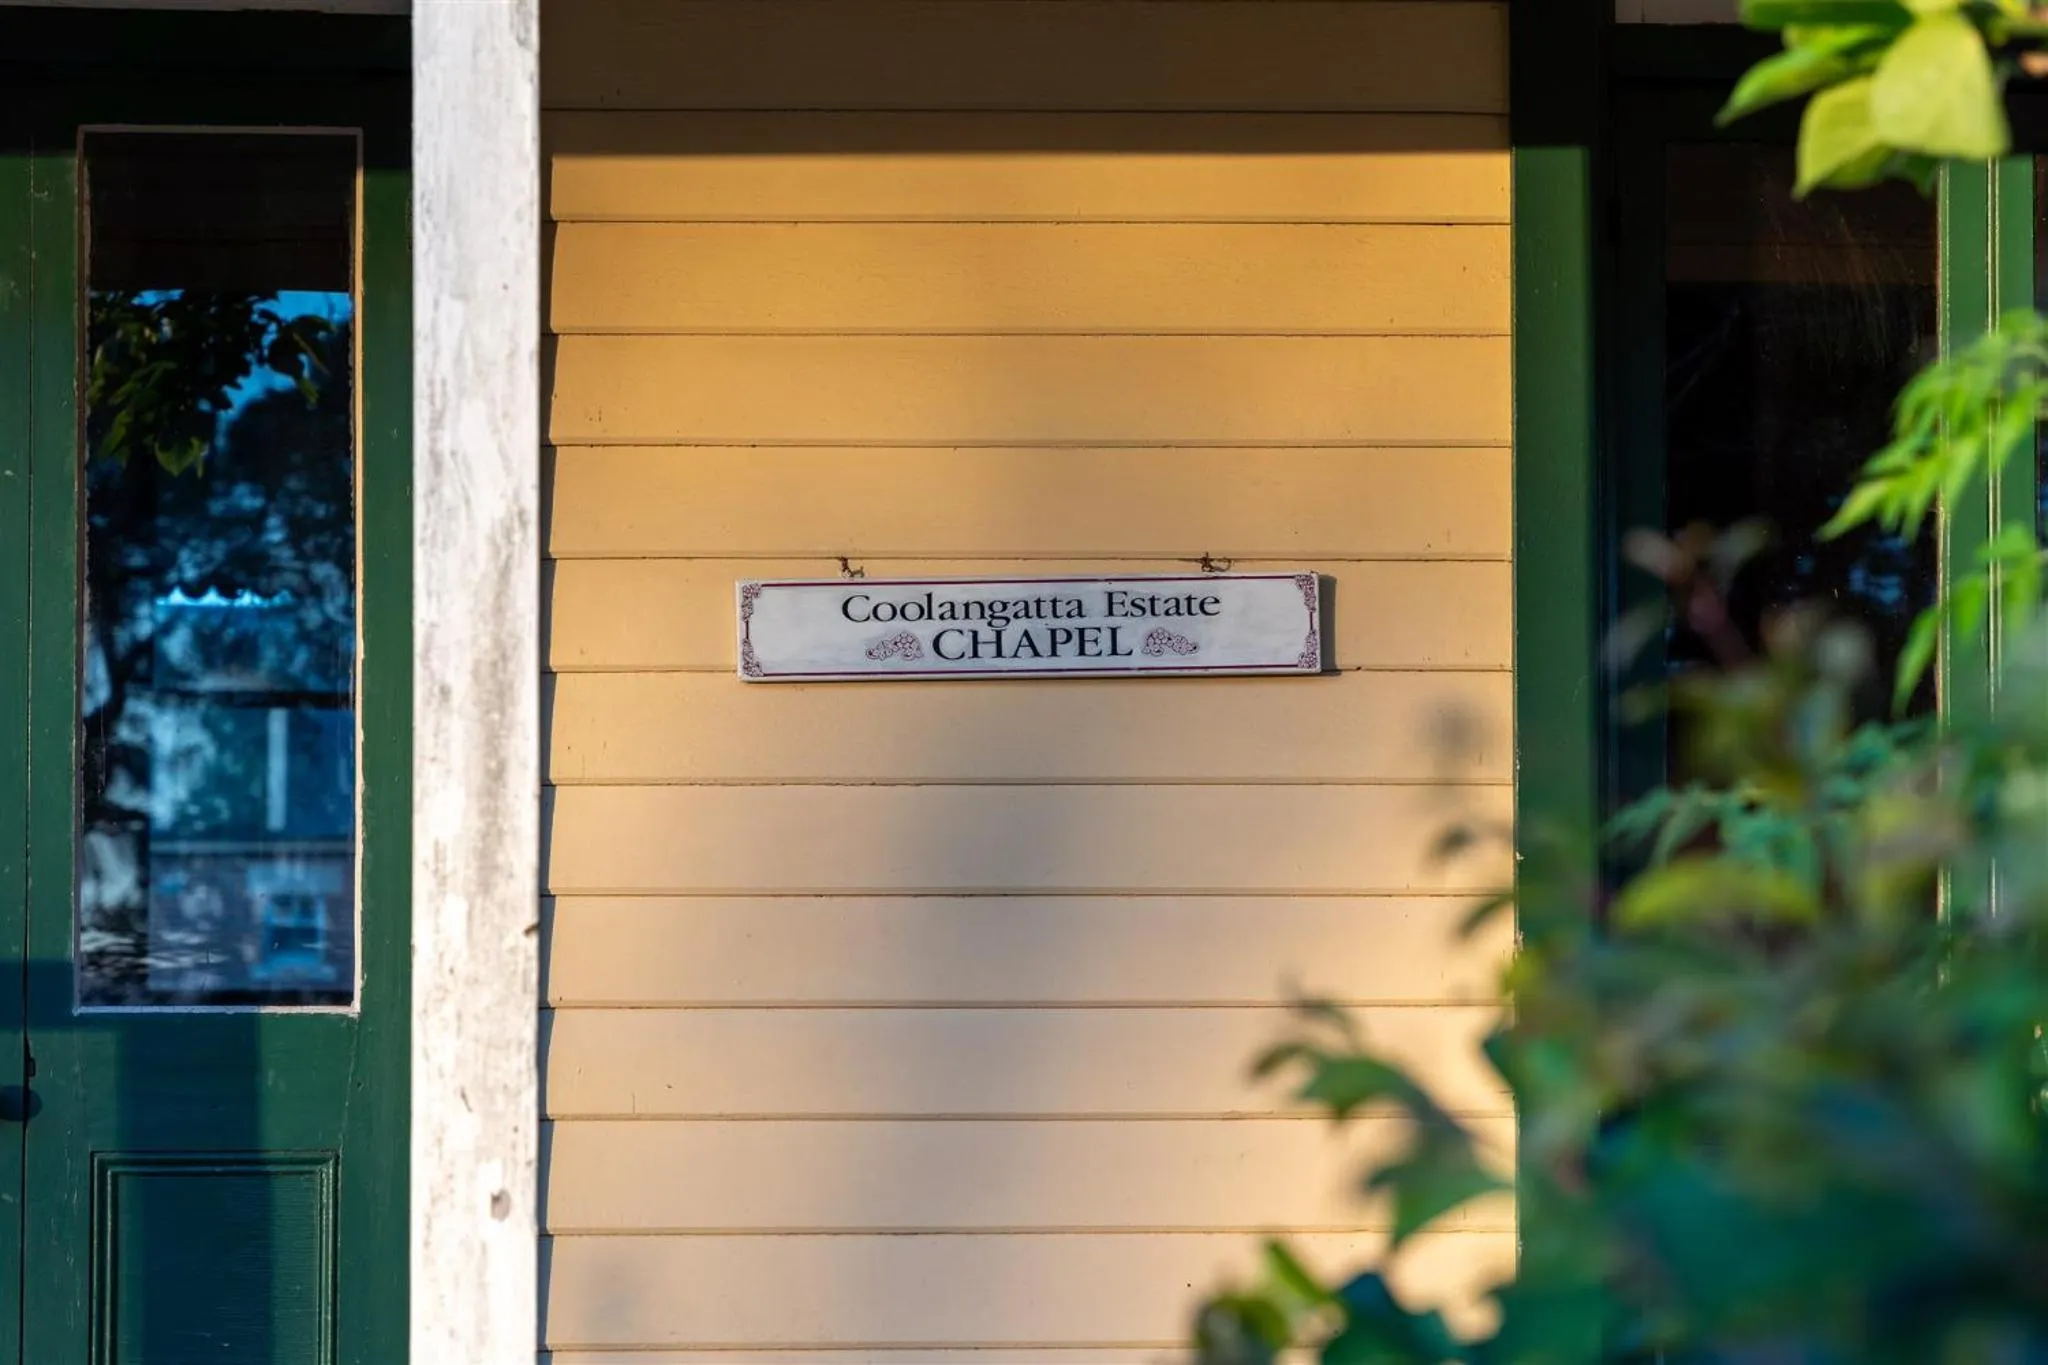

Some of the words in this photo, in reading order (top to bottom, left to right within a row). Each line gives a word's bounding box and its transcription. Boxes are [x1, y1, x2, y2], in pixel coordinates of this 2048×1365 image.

[841, 592, 1087, 628] Coolangatta
[1103, 590, 1221, 618] Estate
[931, 625, 1134, 661] CHAPEL
